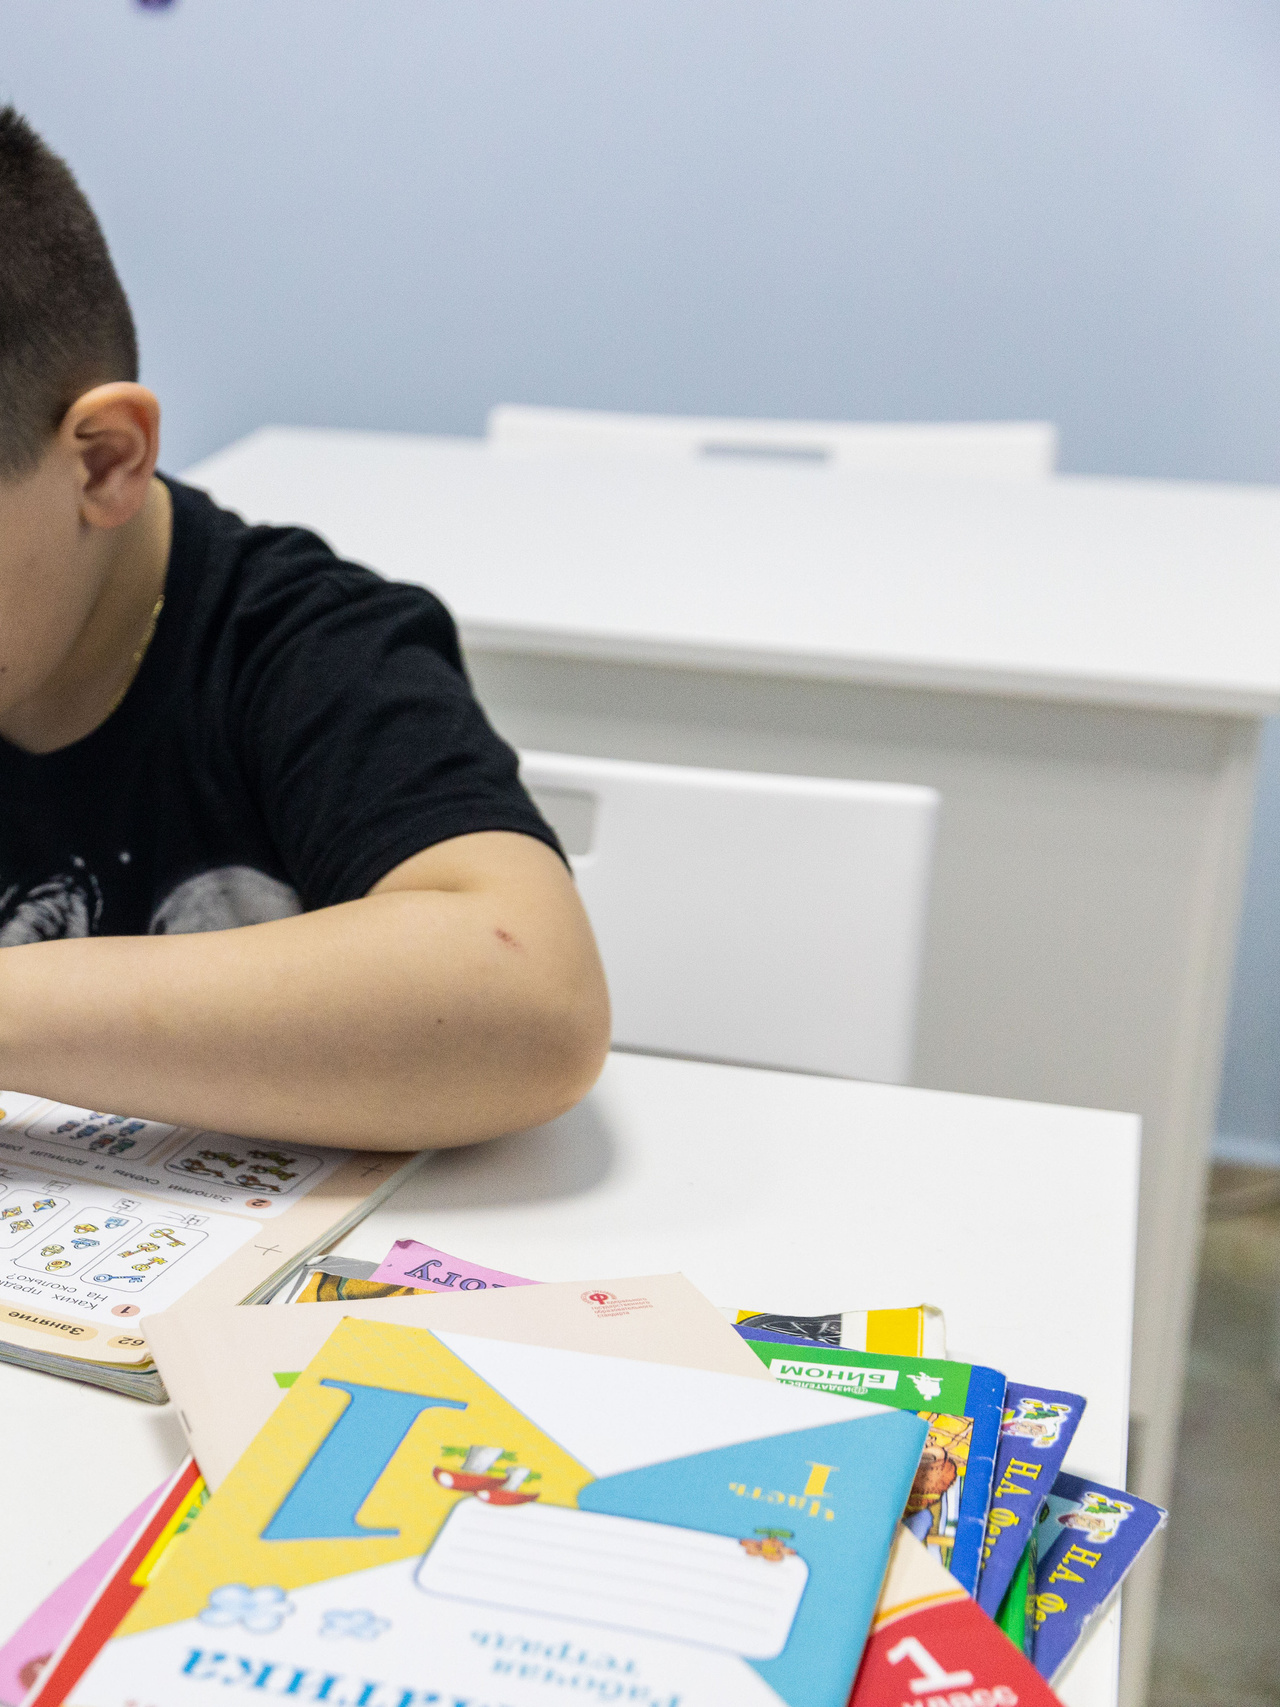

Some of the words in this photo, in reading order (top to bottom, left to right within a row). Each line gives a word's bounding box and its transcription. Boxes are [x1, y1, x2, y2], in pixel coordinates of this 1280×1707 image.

[6, 1272, 78, 1294] сколько?
[404, 1259, 506, 1291] огу
[51, 1294, 99, 1310] Каких
[86, 1291, 108, 1302] На
[8, 1311, 85, 1336] Занятие
[118, 1336, 145, 1347] 62
[780, 1364, 886, 1387] БИНОМ
[259, 1378, 469, 1542] 1
[728, 1482, 835, 1522] Часть
[470, 1631, 639, 1680] тетрадь
[887, 1636, 974, 1695] 1
[181, 1649, 502, 1707] атика
